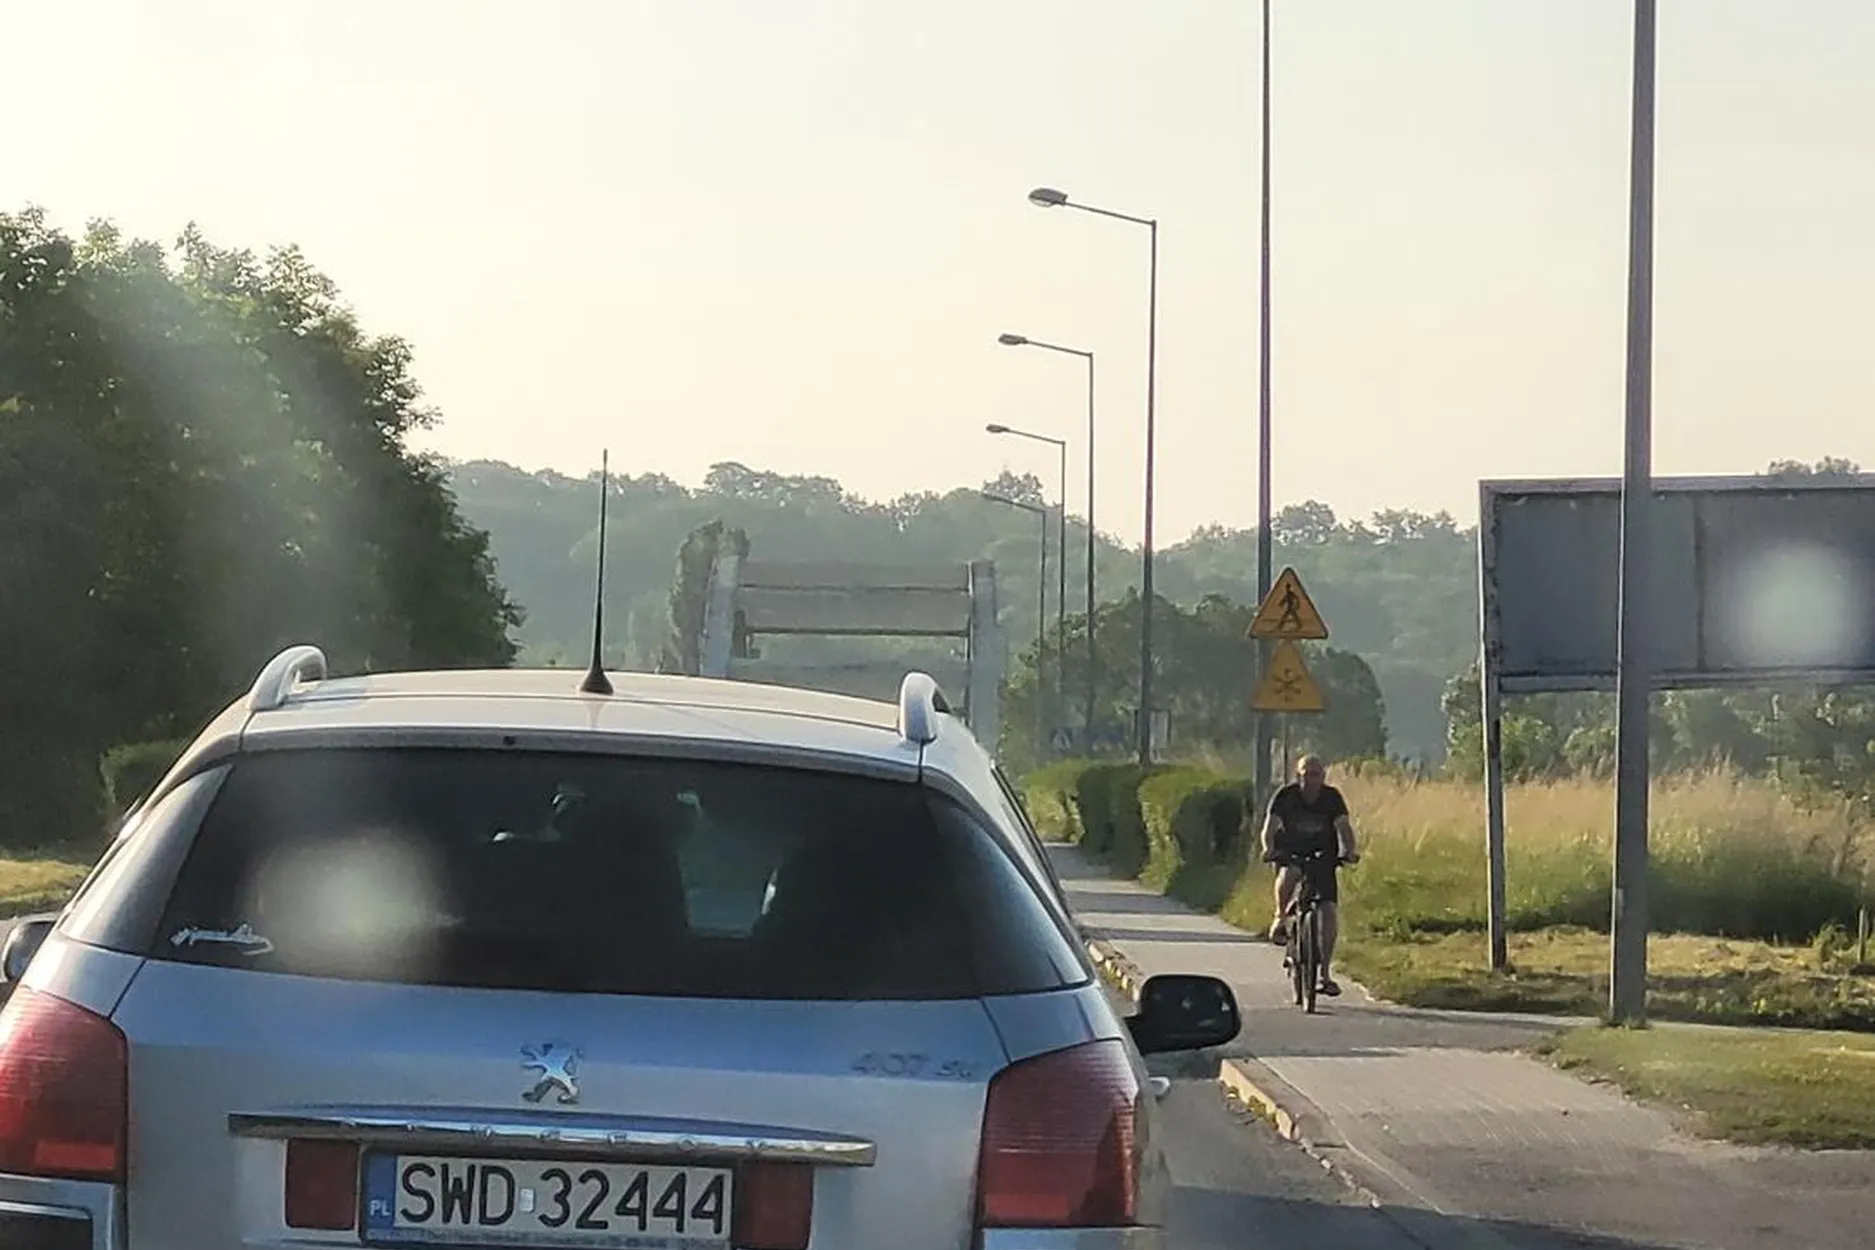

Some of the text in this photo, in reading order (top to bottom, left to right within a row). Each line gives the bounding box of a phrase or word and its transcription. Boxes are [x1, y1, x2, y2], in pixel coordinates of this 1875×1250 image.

[370, 1199, 391, 1216] PL
[400, 1162, 725, 1235] SWD 32444
